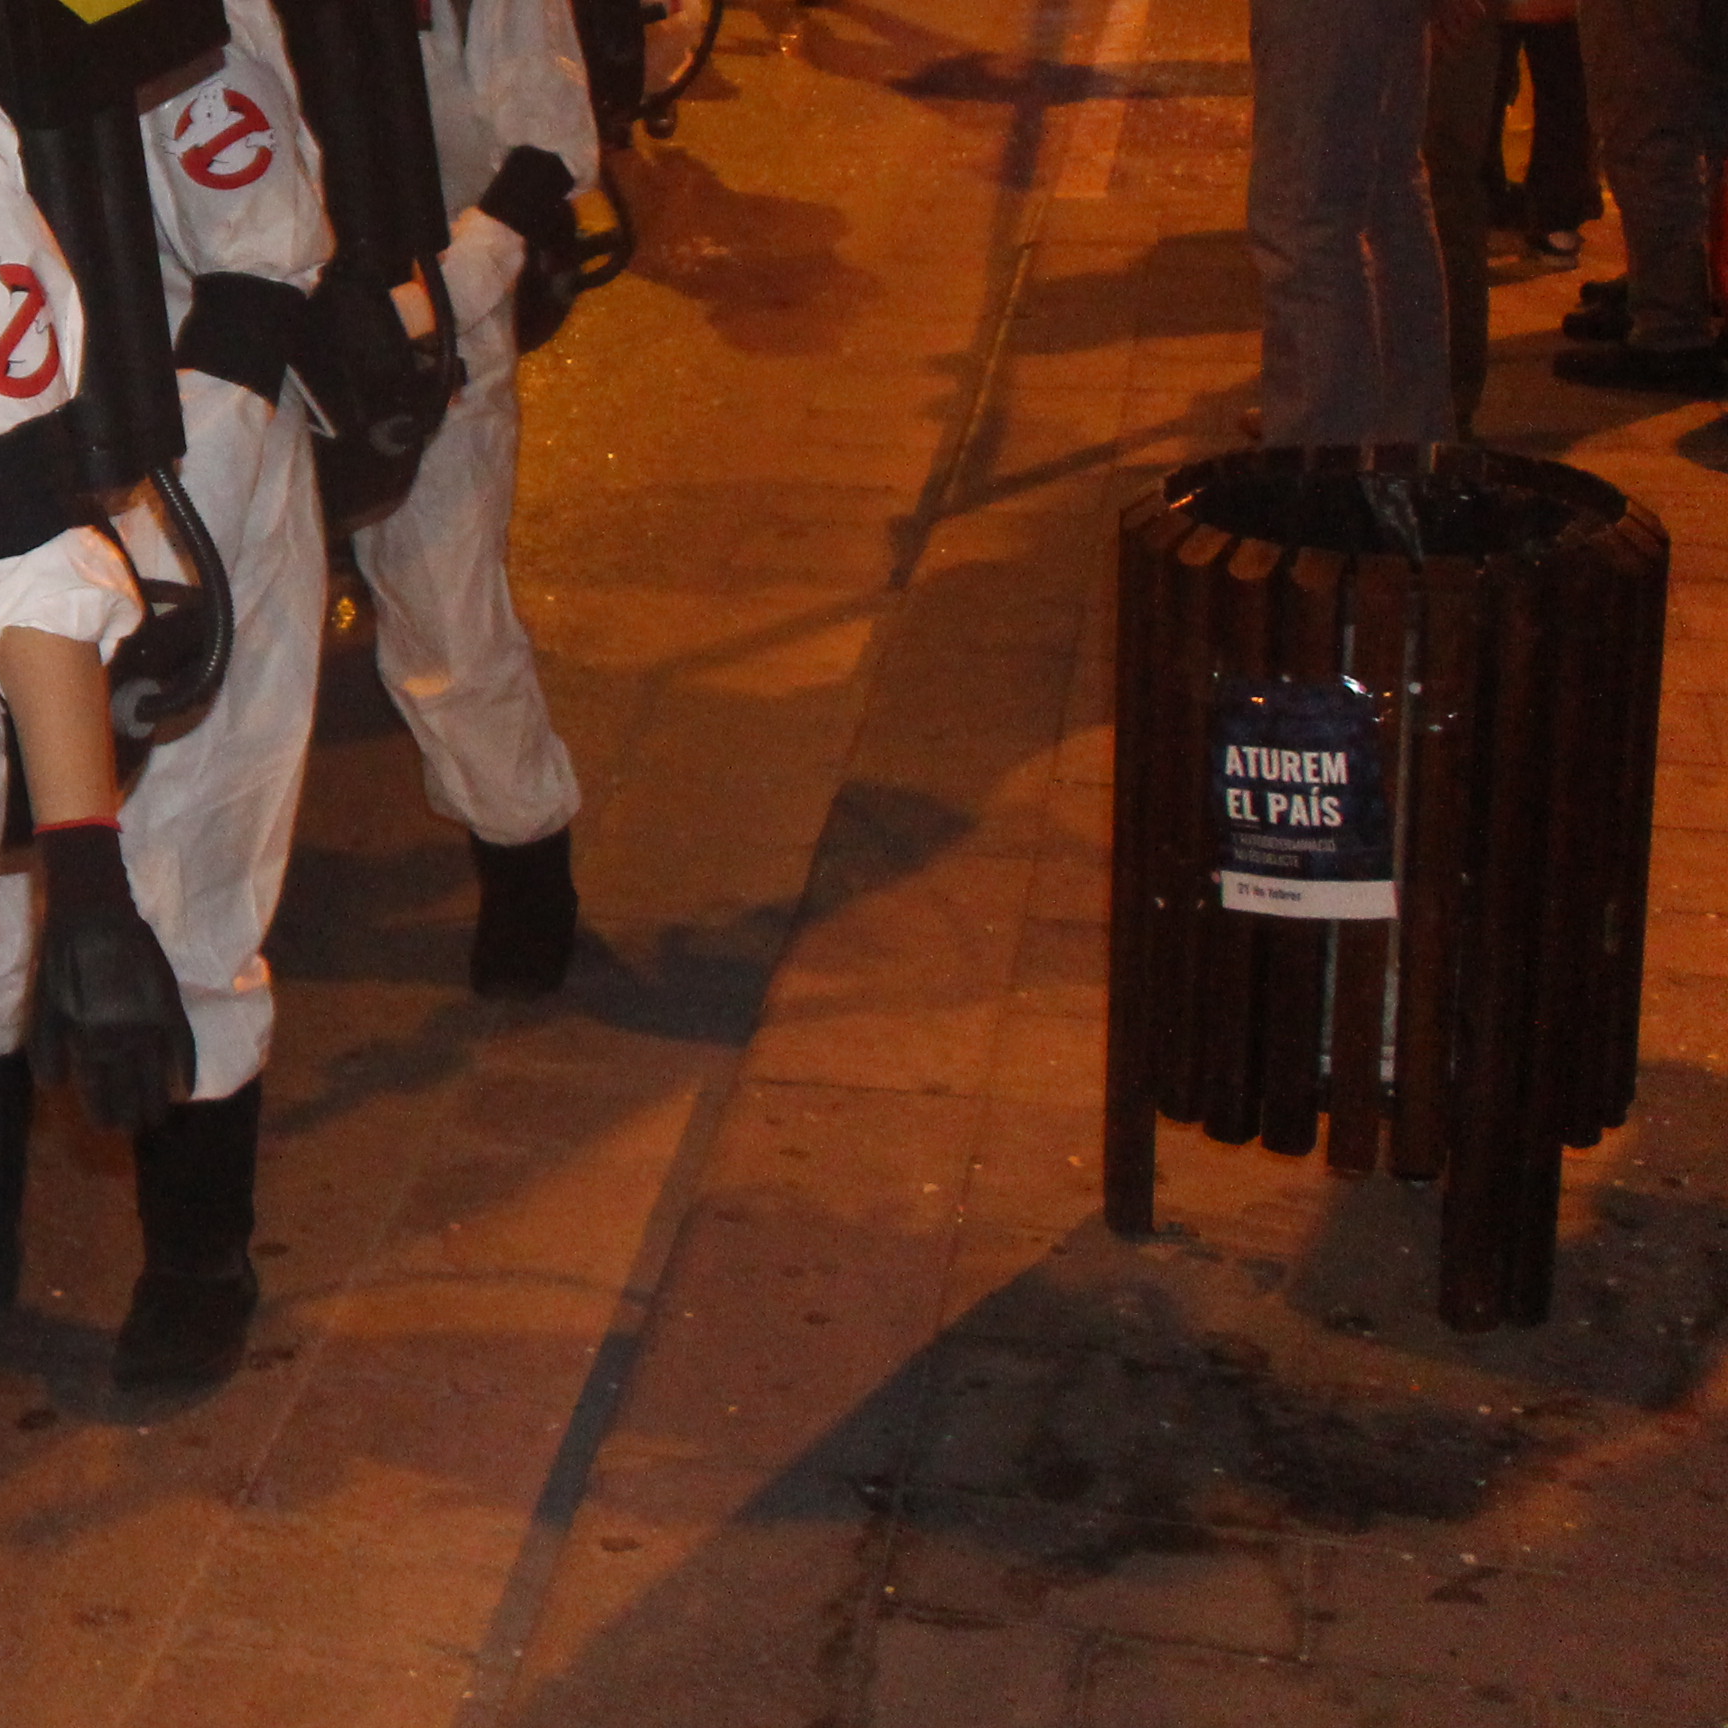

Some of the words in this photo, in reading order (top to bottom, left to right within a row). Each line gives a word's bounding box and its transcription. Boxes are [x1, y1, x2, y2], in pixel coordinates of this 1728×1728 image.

[1224, 744, 1350, 785] ATUREM
[1226, 788, 1260, 822] EL
[1266, 786, 1343, 827] PAÍS
